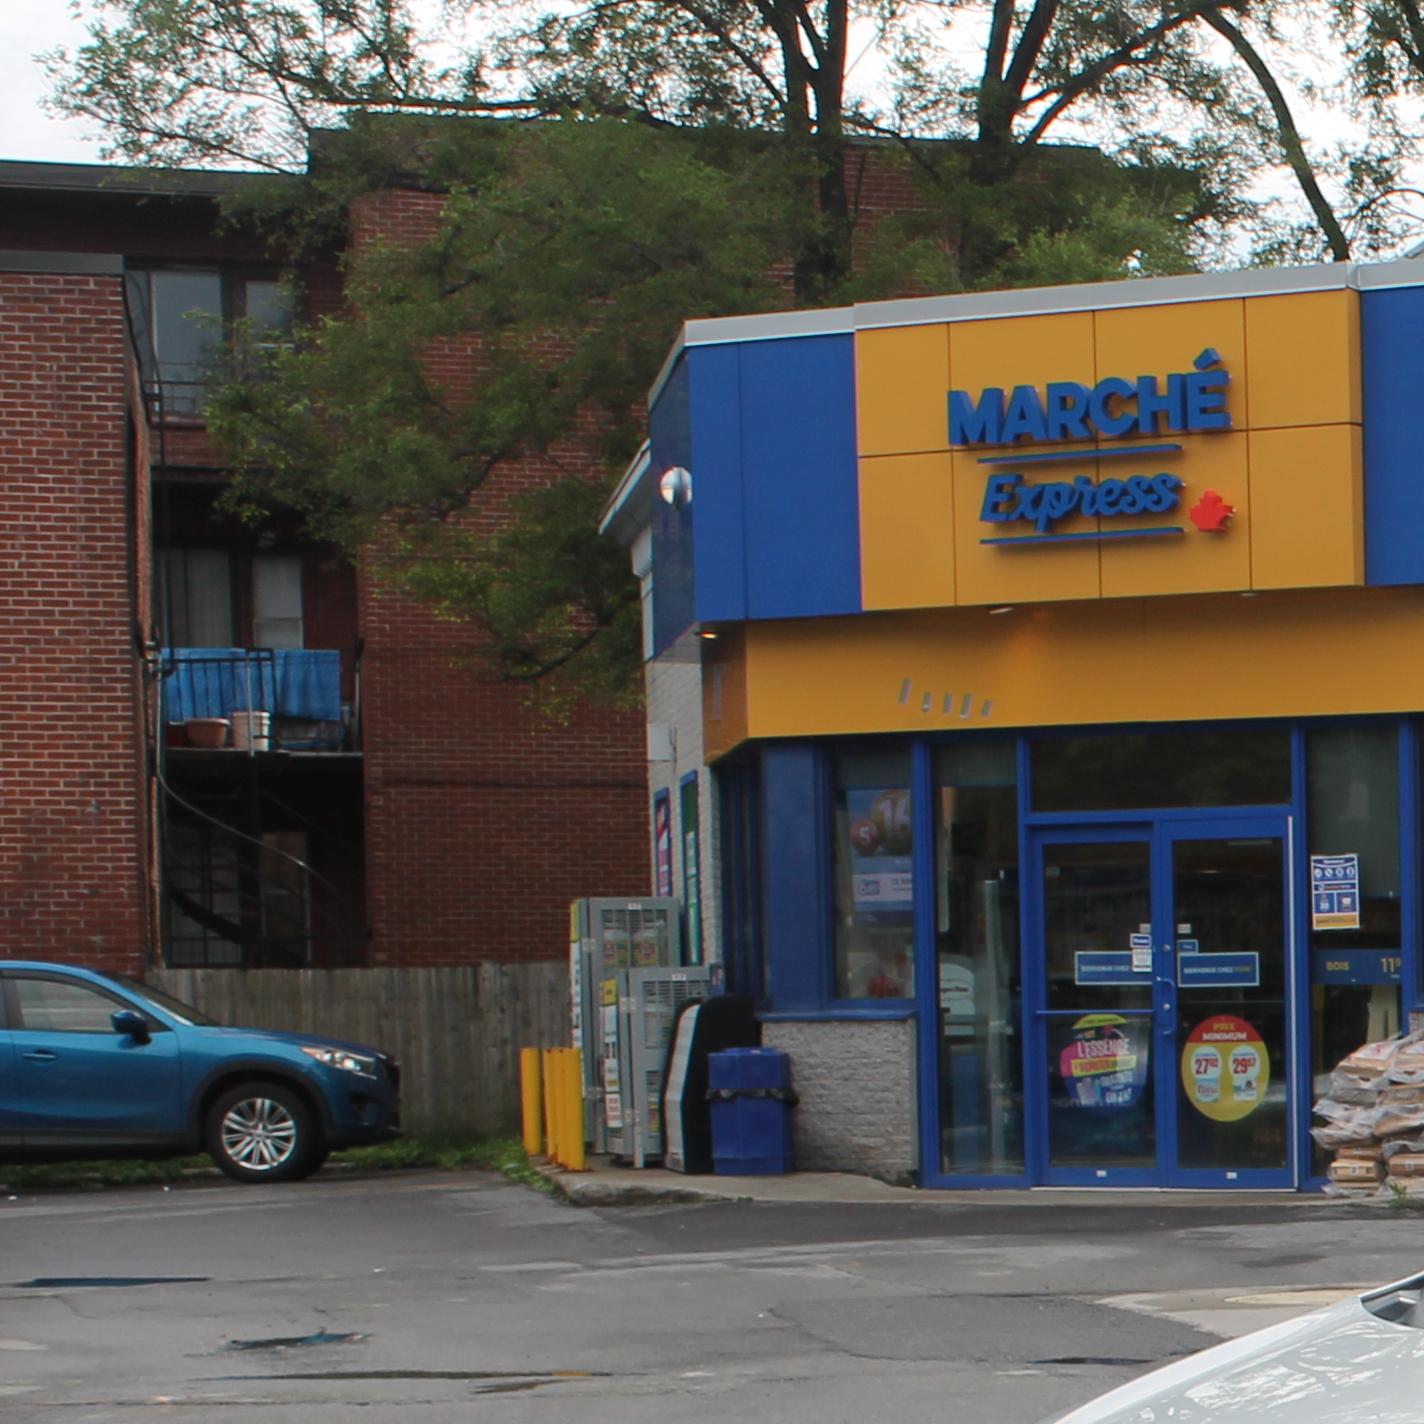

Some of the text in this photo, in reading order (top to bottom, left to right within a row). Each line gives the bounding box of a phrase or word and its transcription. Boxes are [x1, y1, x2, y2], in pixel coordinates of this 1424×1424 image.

[947, 347, 1231, 446] MARCHÉ
[979, 473, 1182, 532] Express
[859, 826, 871, 845] 5
[1202, 1032, 1247, 1041] MINIMUM
[1077, 1039, 1131, 1058] L'ESSENCE
